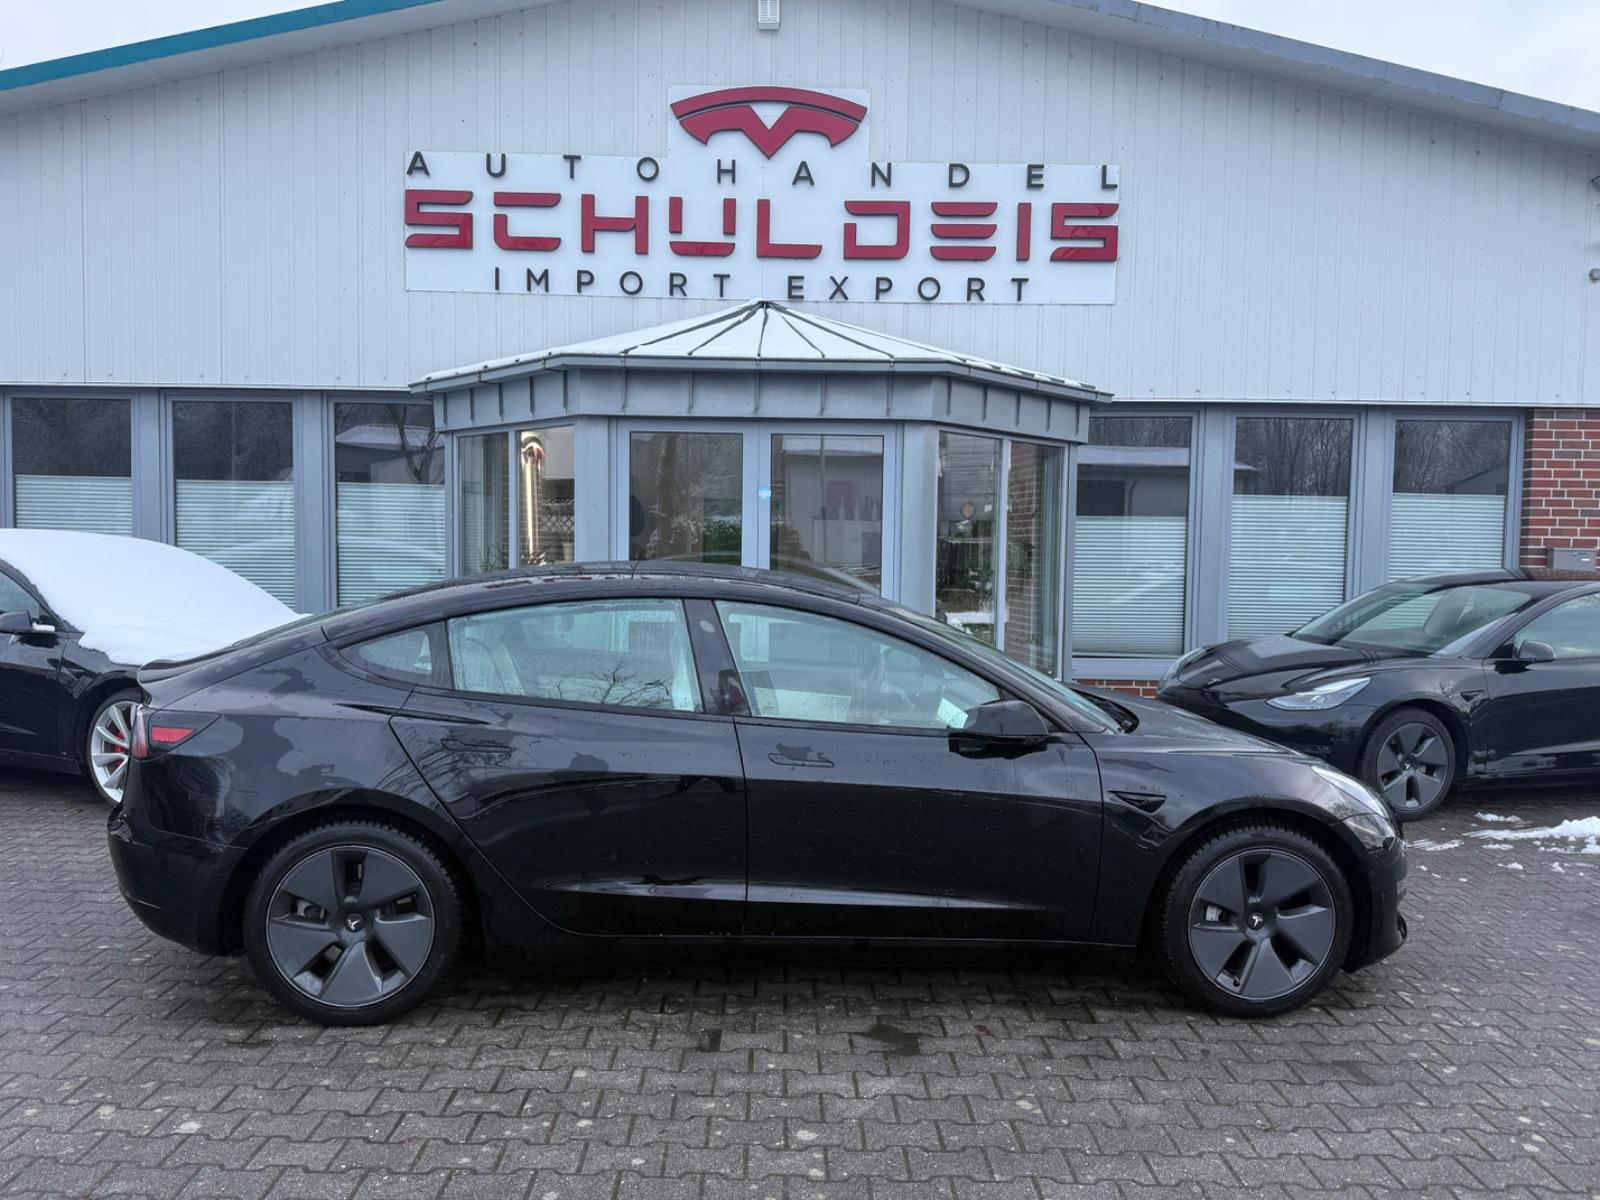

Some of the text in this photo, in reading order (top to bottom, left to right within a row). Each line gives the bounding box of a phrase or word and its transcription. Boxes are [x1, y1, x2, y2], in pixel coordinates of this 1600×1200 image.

[406, 151, 1118, 189] AUTOHANDEL
[405, 189, 1119, 262] SCHULDEIS
[494, 267, 1029, 302] IMPORT EXPORT
